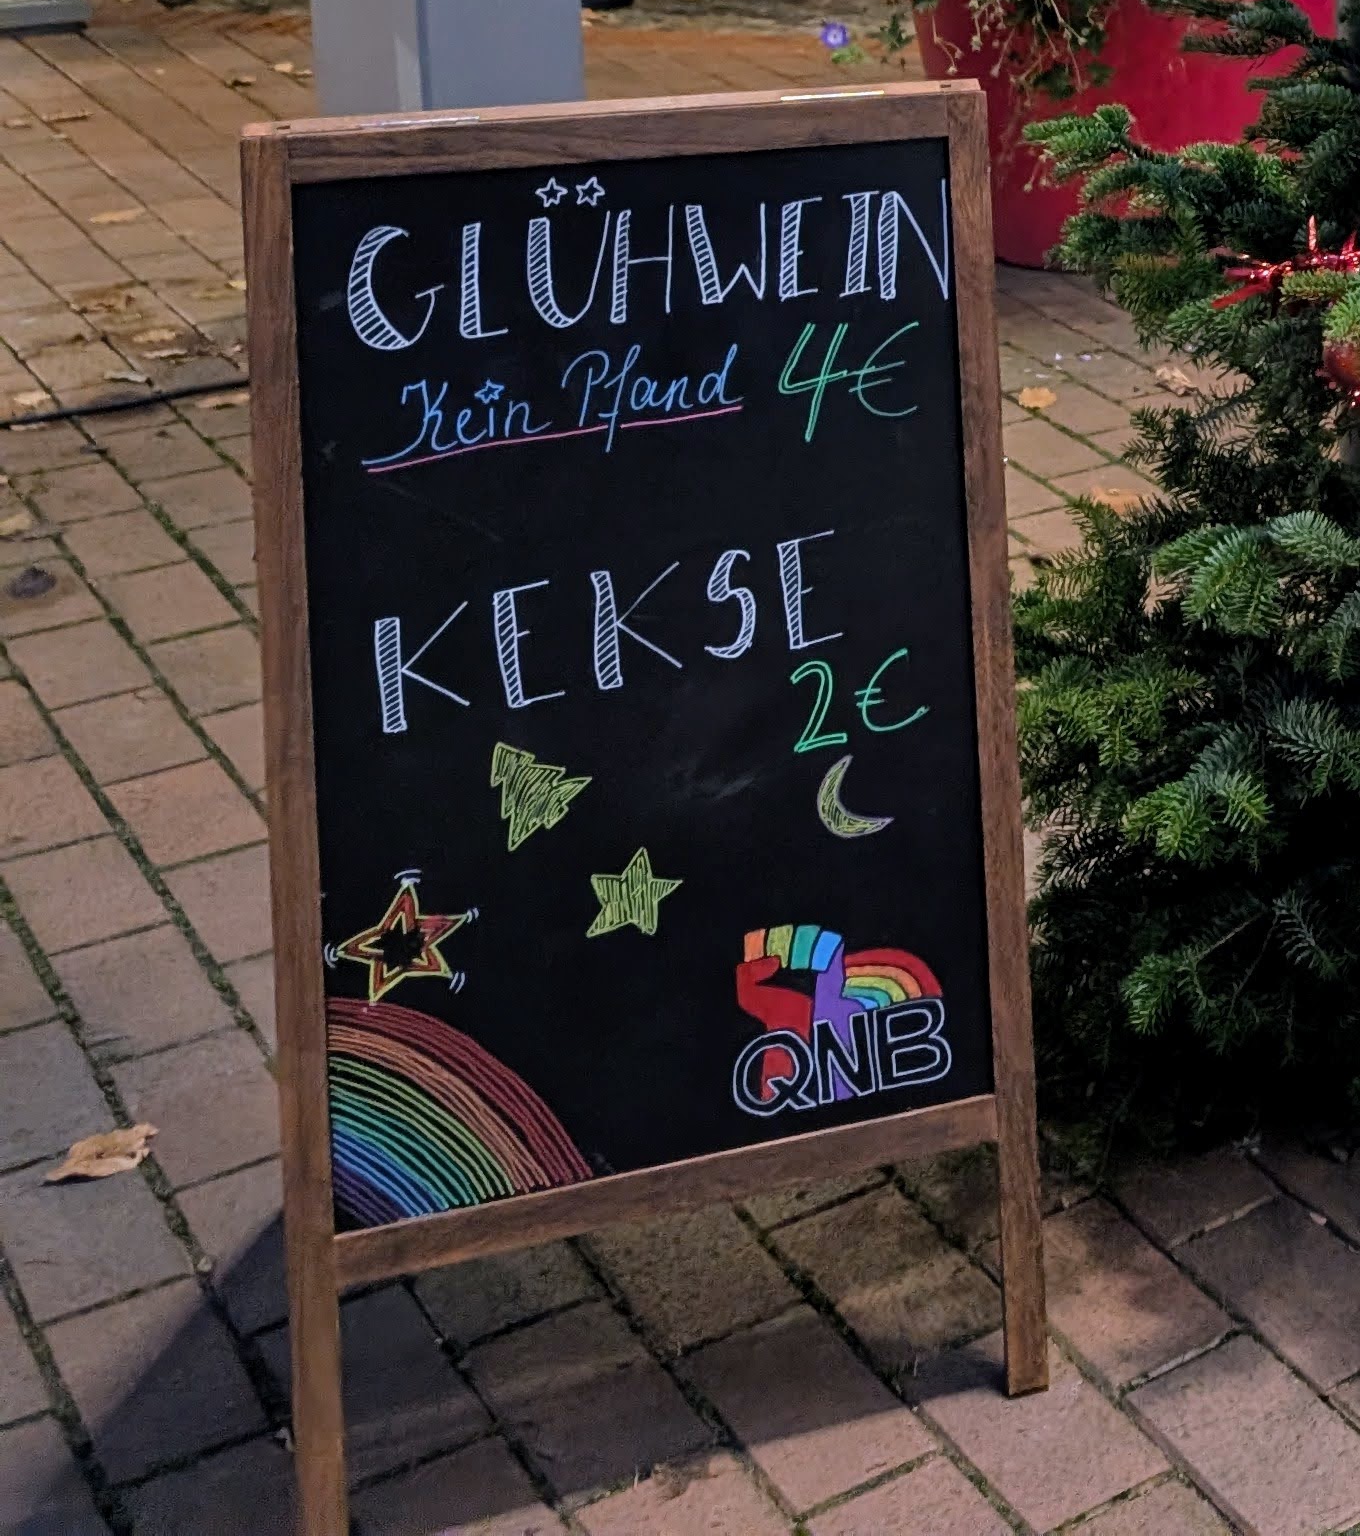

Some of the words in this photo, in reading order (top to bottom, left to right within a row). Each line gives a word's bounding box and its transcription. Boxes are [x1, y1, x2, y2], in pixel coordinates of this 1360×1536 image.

[347, 177, 950, 350] GLÜHWEIN
[361, 378, 551, 465] Kein
[561, 343, 744, 453] Pfand
[373, 530, 843, 734] KEKSE
[732, 997, 952, 1117] QNB
